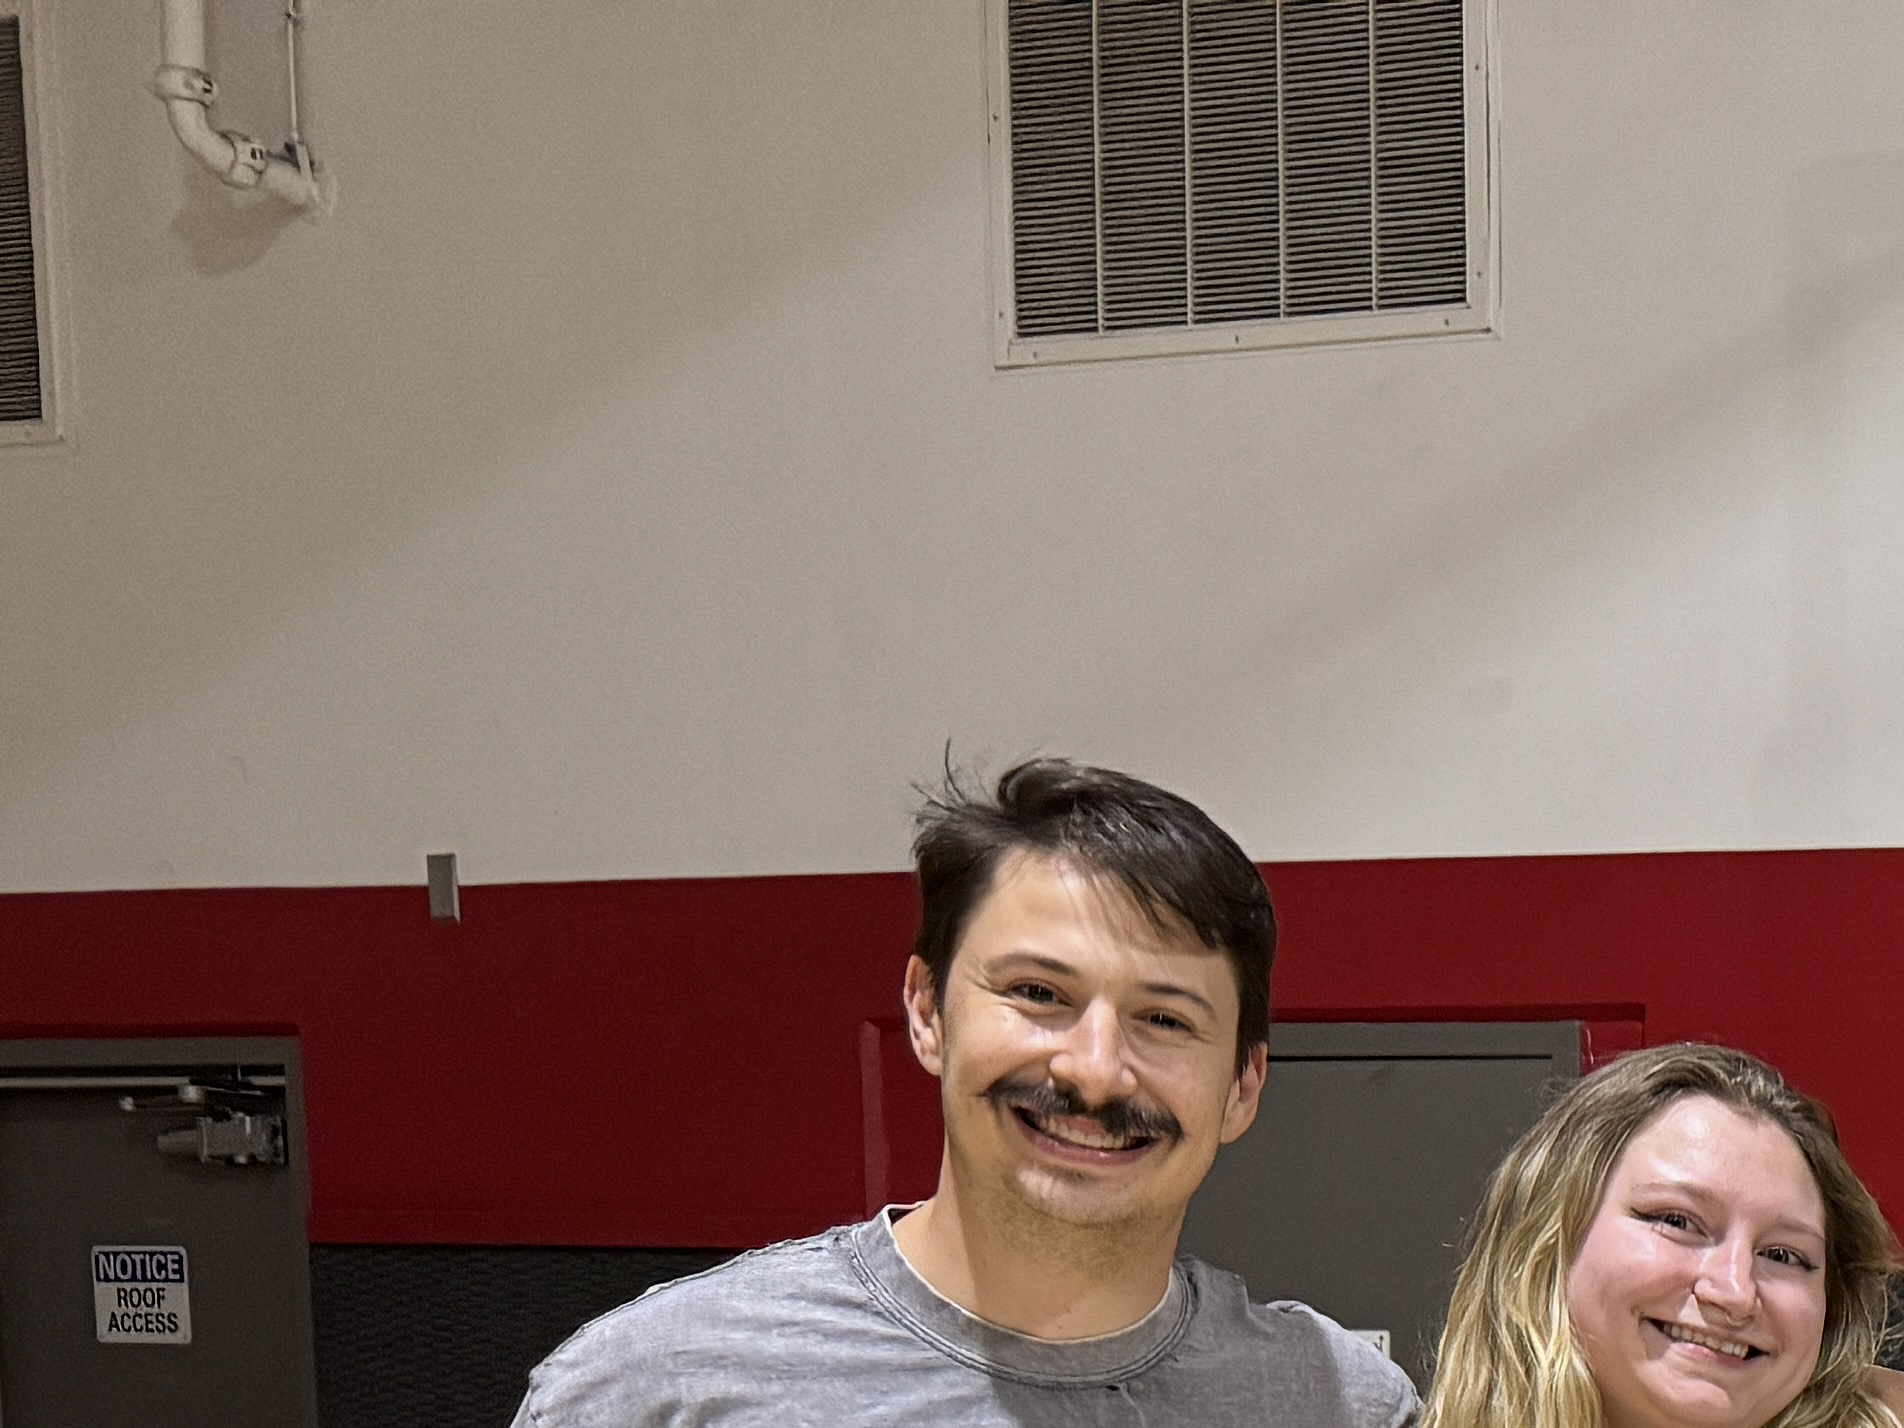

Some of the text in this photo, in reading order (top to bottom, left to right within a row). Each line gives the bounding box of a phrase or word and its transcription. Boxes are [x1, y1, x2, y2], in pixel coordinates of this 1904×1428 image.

[99, 1252, 181, 1280] NOTICE
[116, 1287, 166, 1309] ROOF
[108, 1311, 179, 1333] ACCESS
